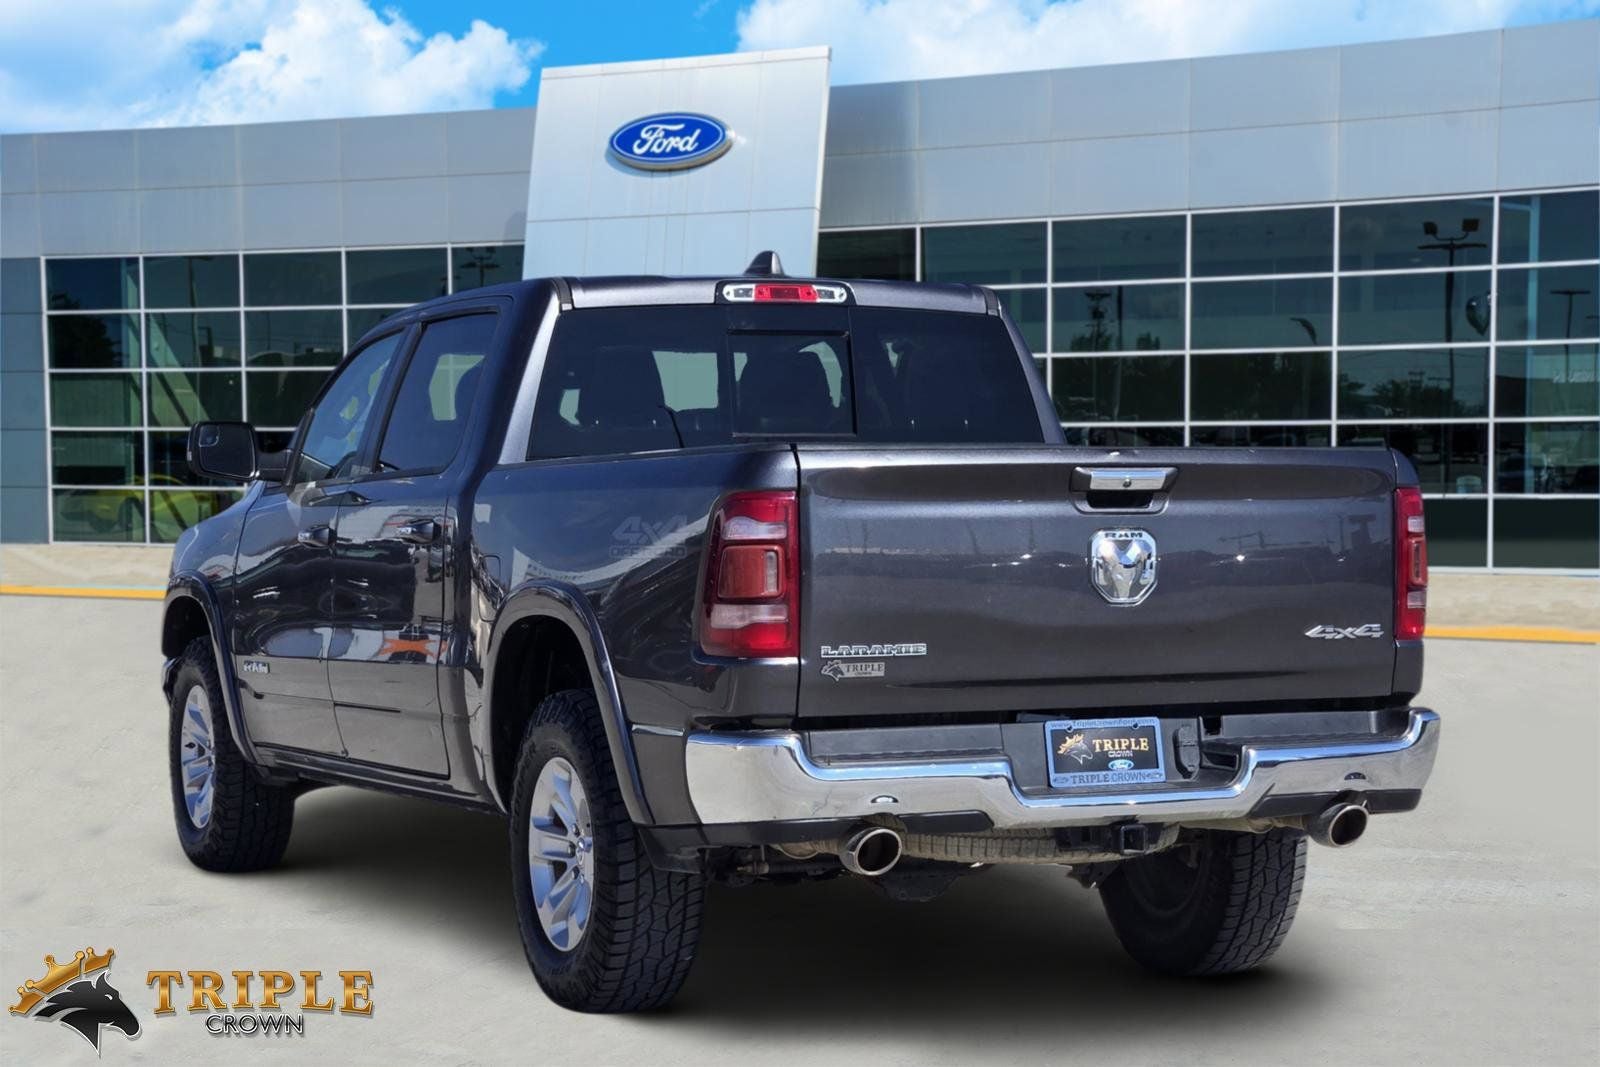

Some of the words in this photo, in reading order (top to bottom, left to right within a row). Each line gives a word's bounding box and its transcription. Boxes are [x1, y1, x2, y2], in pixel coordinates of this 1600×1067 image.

[632, 123, 701, 155] Ford
[820, 643, 927, 658] LARAMIE
[243, 660, 270, 674] RAM
[845, 663, 884, 673] TRIPLE
[1092, 738, 1149, 752] TRIPLE
[1071, 773, 1110, 784] TRIPLE
[1110, 772, 1147, 782] CROWN
